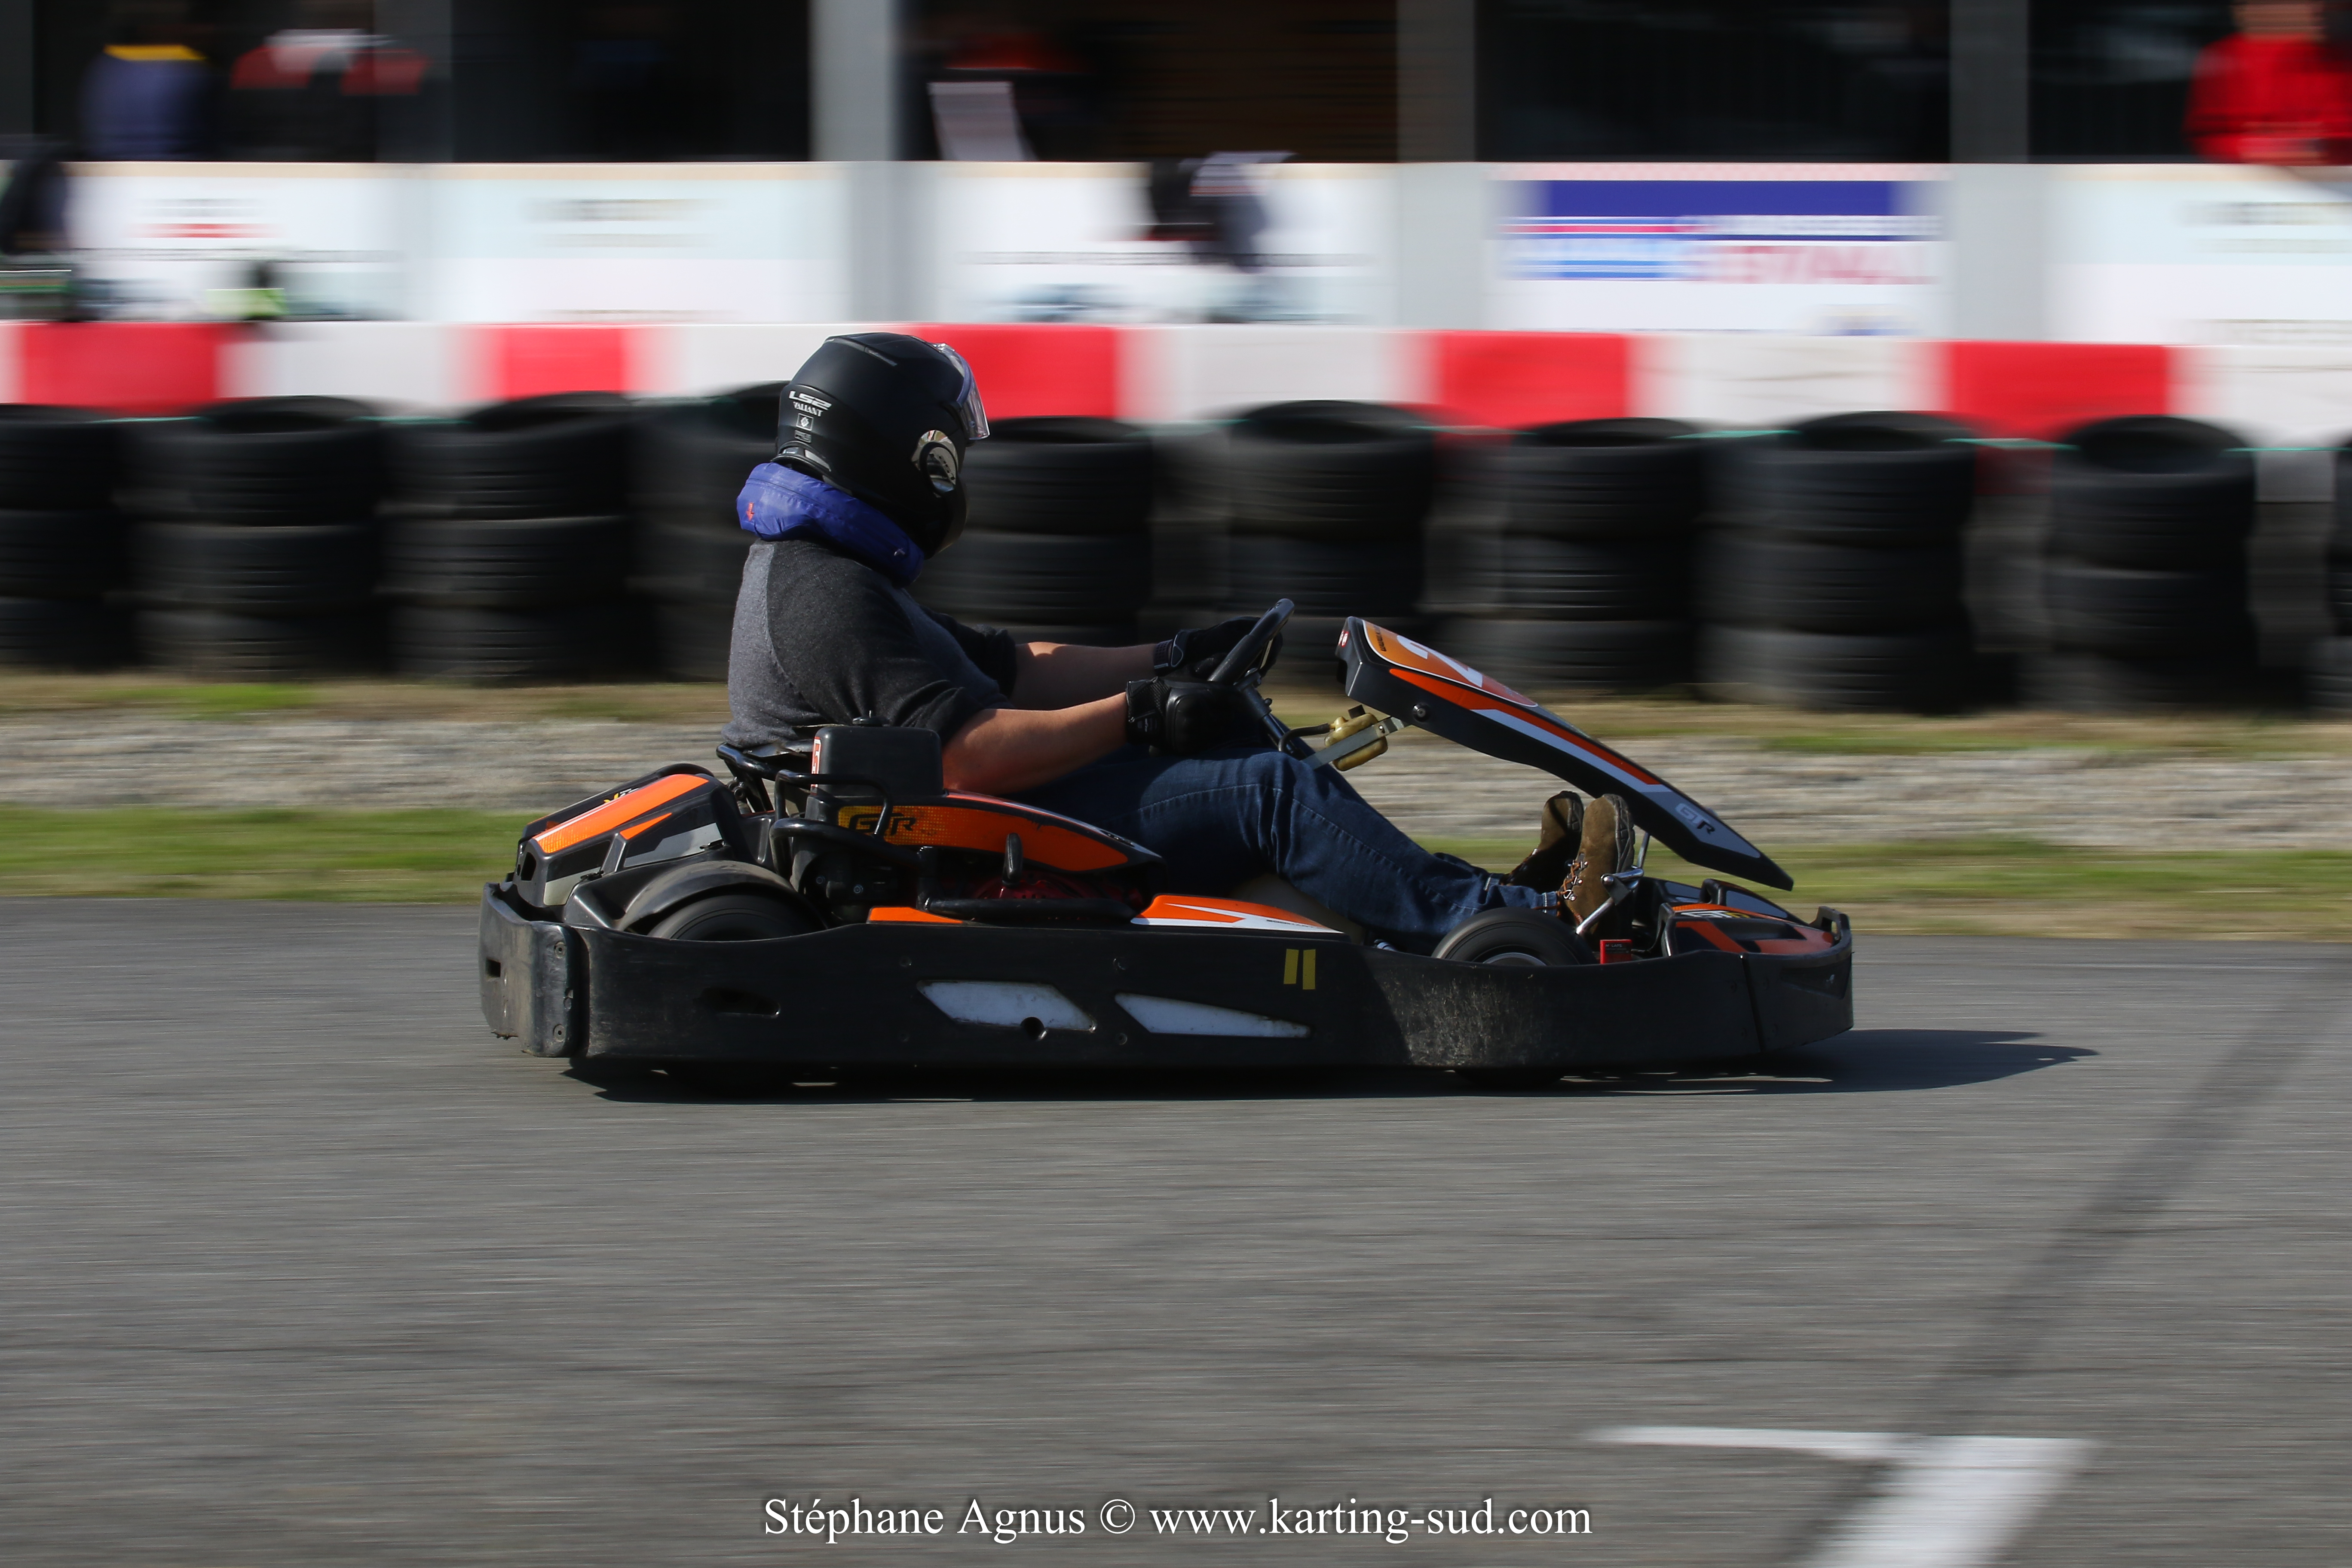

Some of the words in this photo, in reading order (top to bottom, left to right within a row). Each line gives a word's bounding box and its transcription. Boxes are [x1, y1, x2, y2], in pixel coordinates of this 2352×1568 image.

[789, 391, 832, 410] LS2
[793, 401, 823, 416] VALIANT
[1675, 803, 1715, 834] GTR
